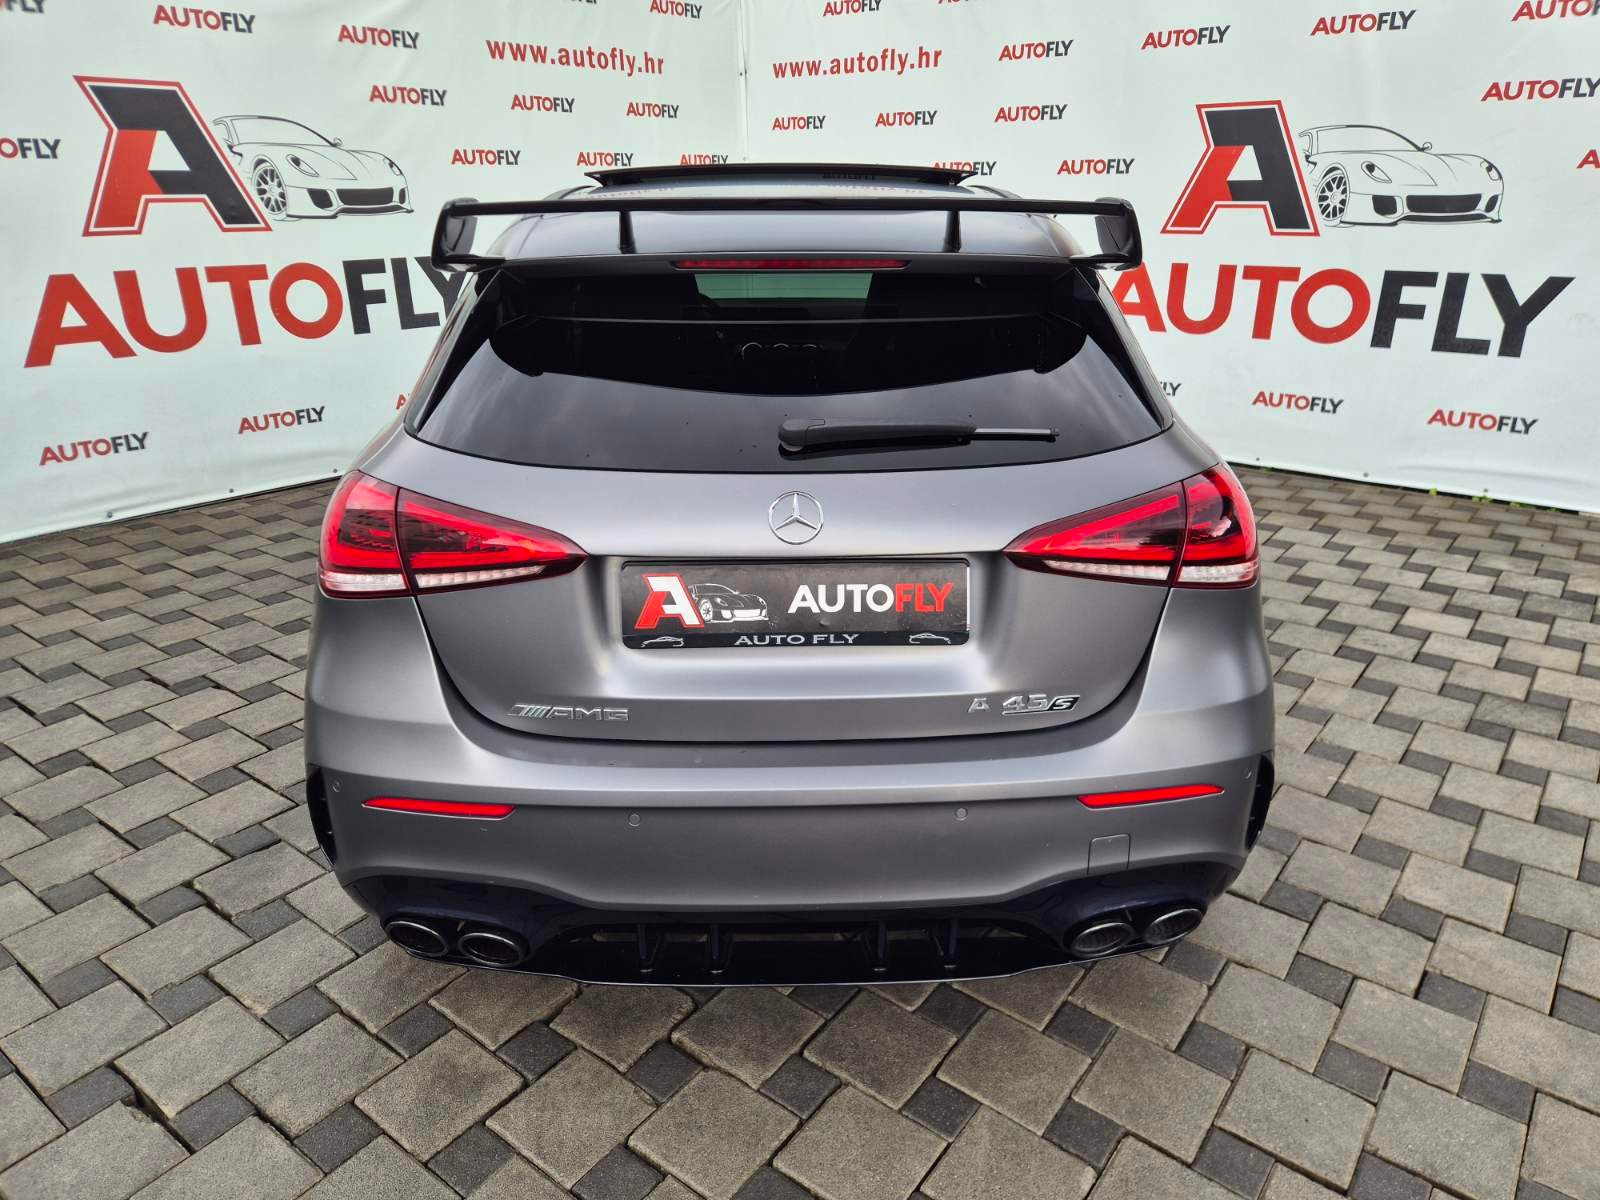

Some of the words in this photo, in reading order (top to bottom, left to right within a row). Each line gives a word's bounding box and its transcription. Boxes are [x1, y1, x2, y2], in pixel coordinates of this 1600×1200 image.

[153, 5, 256, 33] AUTOFLY
[650, 0, 702, 19] AUTOFLY
[823, 0, 882, 17] AUTOFLY
[1311, 10, 1416, 36] AUTOFLY
[338, 25, 420, 49] AUTOFLY
[1142, 25, 1231, 50] AUTOFLY
[486, 40, 664, 77] www.autofly.hr
[999, 40, 1074, 61] AUTOFLY
[773, 46, 942, 79] www.autofly.hr
[369, 85, 447, 106] AUTOFLY
[1481, 78, 1600, 102] AUTOFLY
[511, 95, 575, 113] AUTOFLY
[626, 102, 679, 119] AUTOFLY
[995, 104, 1067, 122] AUTOFLY
[772, 116, 826, 131] AUTOFLY
[877, 110, 938, 127] AUTOFLY
[451, 149, 521, 166] AUTOFLY
[577, 152, 633, 167] AUTOFLY
[1057, 158, 1135, 175] AUTOFLY
[24, 256, 466, 369] AUTOFLY
[1112, 262, 1576, 358] AUTOFLY
[1252, 391, 1344, 414] AUTOFLY
[239, 406, 325, 434] AUTOFLY
[1427, 409, 1539, 435] AUTOFLY
[40, 432, 149, 466] AUTOFLY
[788, 583, 954, 614] AUTOFLY
[734, 635, 805, 646] AUTO
[813, 634, 860, 645] FLY
[967, 697, 990, 713] A
